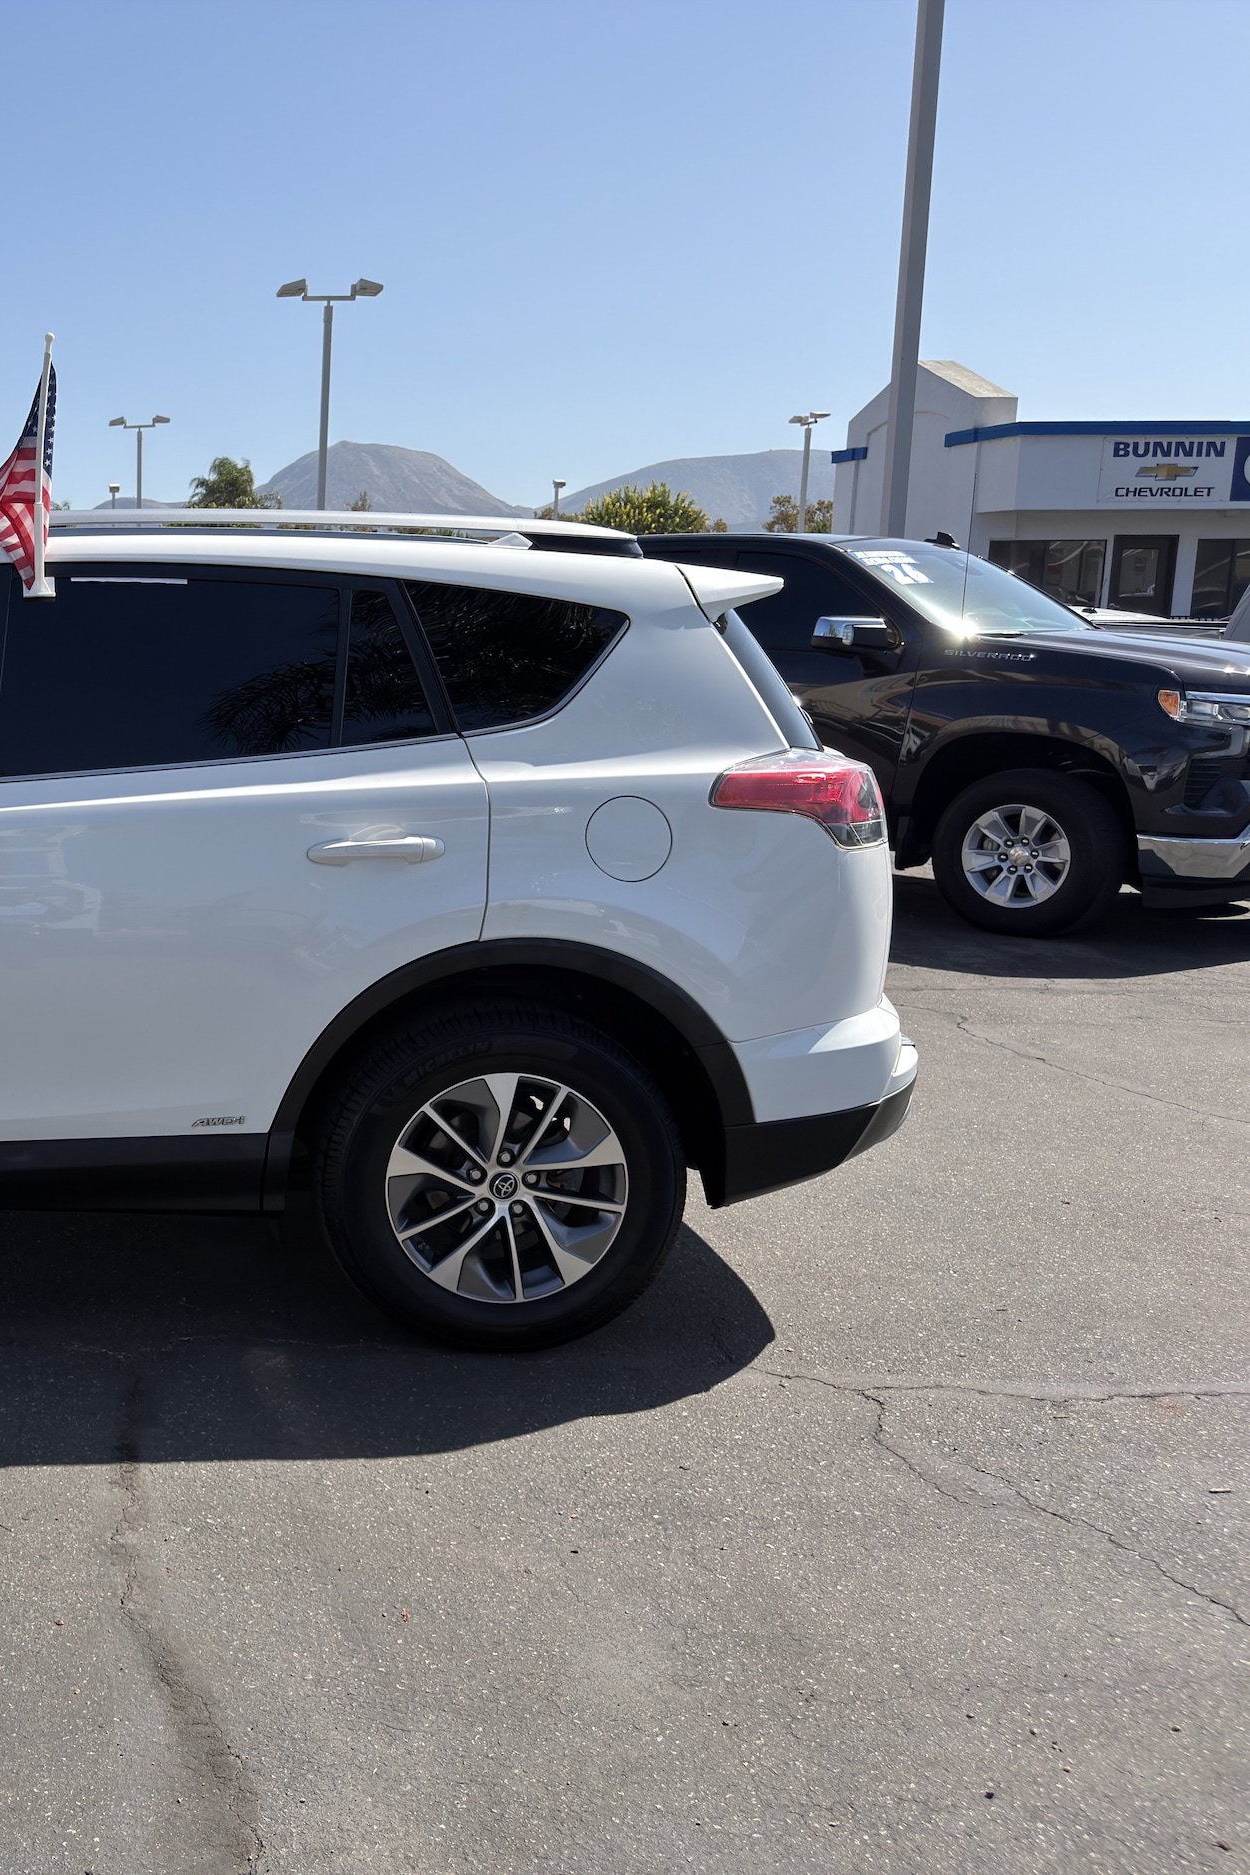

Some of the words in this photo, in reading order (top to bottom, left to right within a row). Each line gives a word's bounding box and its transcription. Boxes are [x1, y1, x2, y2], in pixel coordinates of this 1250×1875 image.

[1112, 441, 1227, 458] BUNNIN
[1114, 486, 1215, 497] CHEVROLET
[943, 649, 1036, 662] SILVERADO
